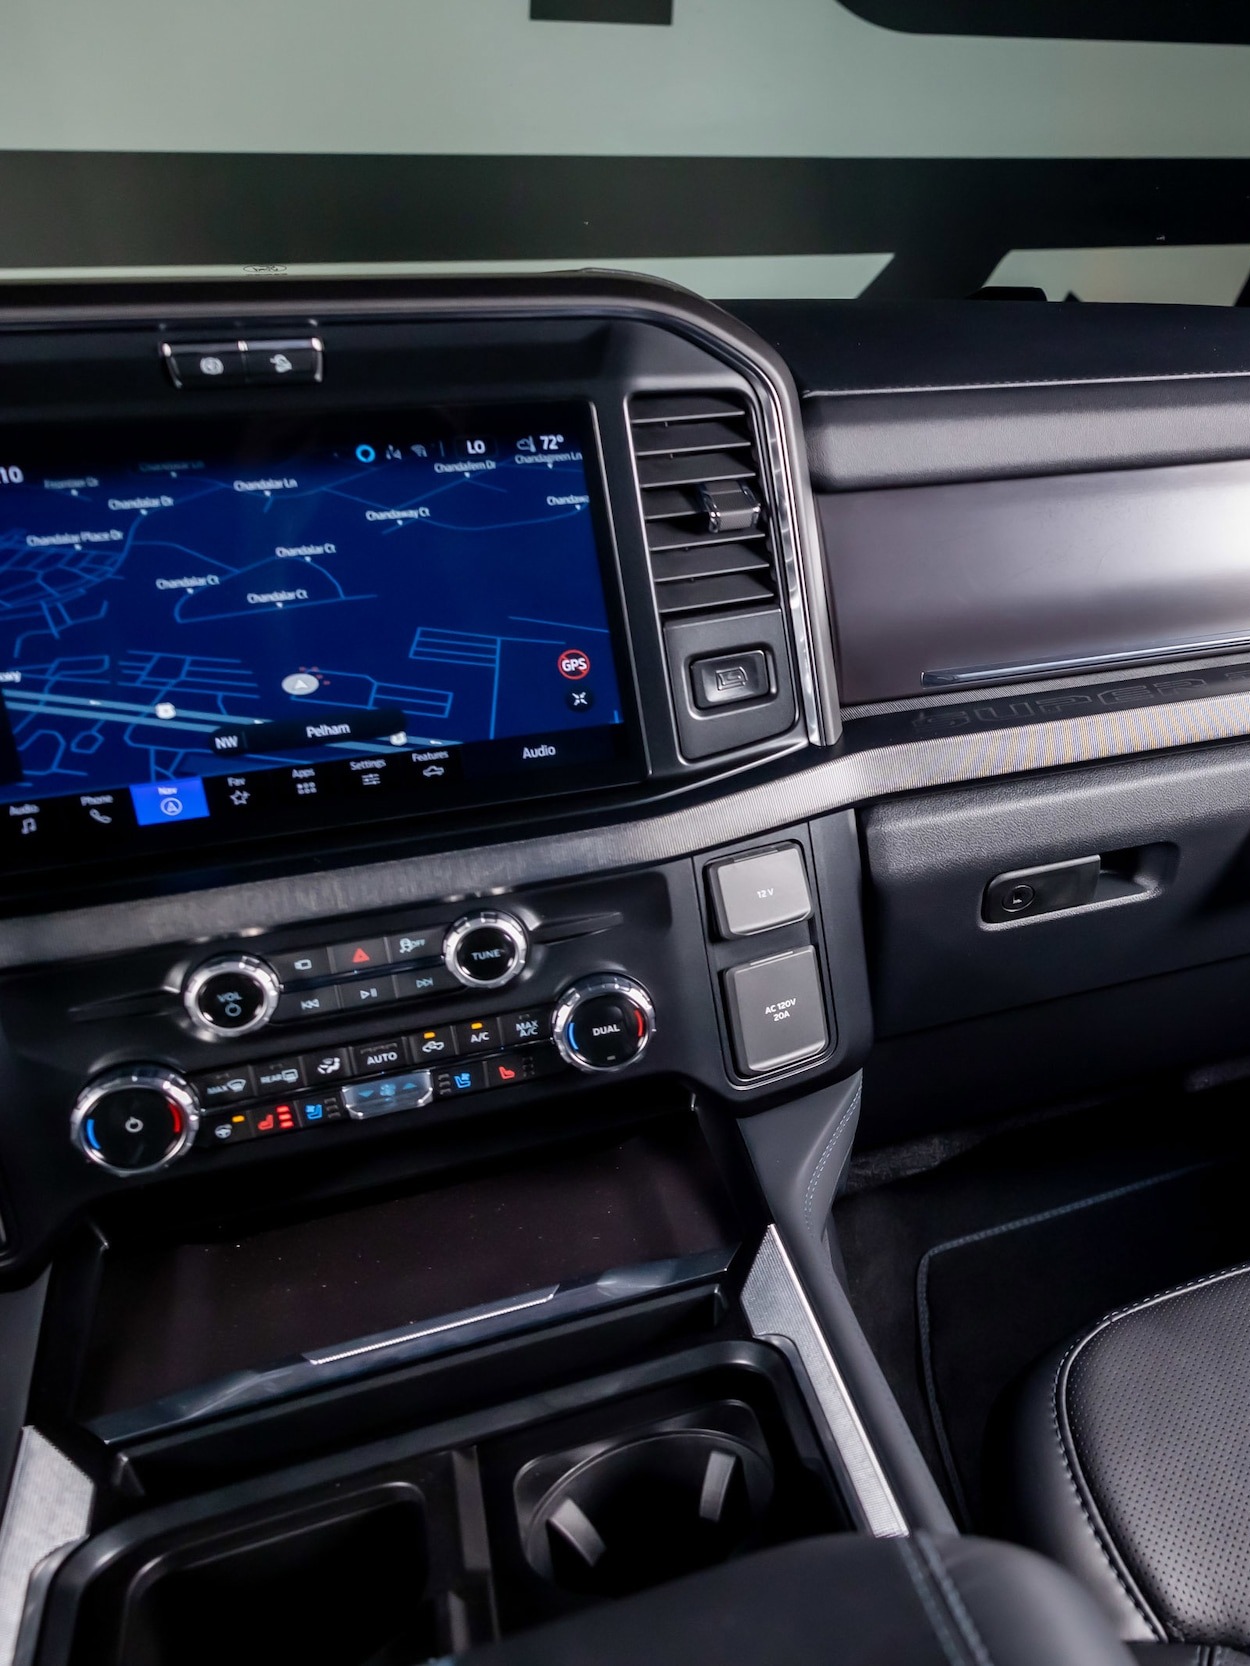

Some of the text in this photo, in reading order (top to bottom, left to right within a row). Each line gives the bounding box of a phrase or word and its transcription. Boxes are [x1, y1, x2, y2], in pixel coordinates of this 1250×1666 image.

[467, 440, 486, 454] LO
[540, 435, 564, 450] 72°
[562, 658, 587, 672] GPS
[911, 677, 1207, 735] SUPER
[306, 723, 350, 738] Pelham
[215, 736, 238, 749] NW
[412, 750, 449, 762] Features
[522, 745, 556, 760] Audio
[350, 758, 386, 772] Settings
[292, 768, 315, 779] Apps
[756, 888, 767, 899] 12
[472, 948, 501, 960] TUNE
[764, 998, 797, 1015] AC 120V
[774, 1010, 790, 1022] 20A
[516, 1020, 539, 1032] MAX
[520, 1026, 538, 1038] A/C
[592, 1025, 620, 1038] DUAL
[470, 1032, 490, 1044] A/C
[366, 1052, 398, 1066] AUTO
